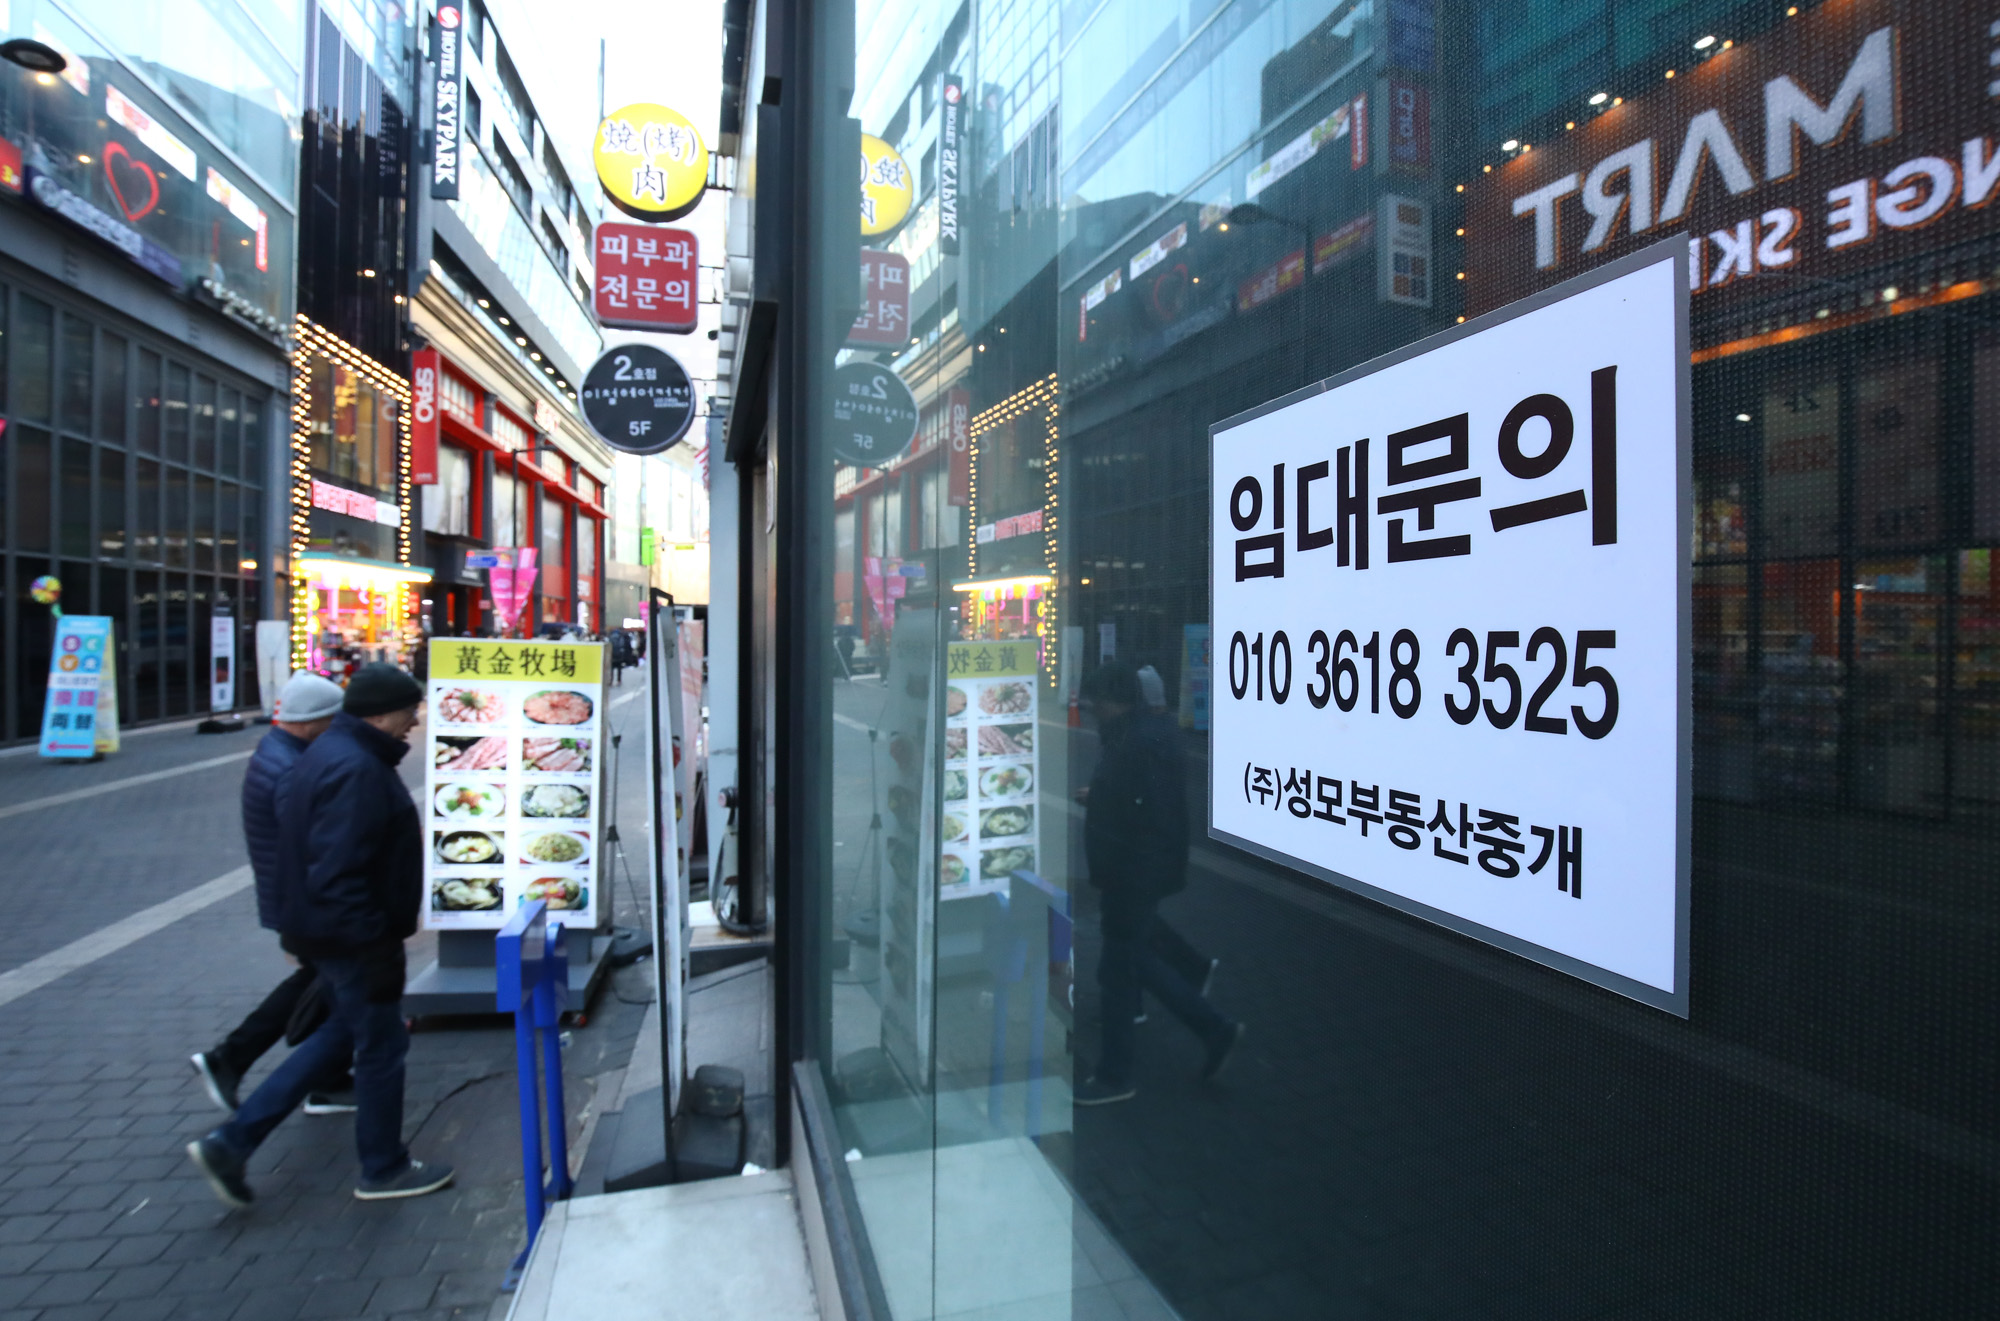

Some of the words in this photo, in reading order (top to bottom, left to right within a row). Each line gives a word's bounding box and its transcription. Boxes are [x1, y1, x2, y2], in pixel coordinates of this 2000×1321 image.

[441, 30, 457, 79] HOTEL
[435, 80, 458, 185] SKYPARK
[635, 164, 665, 201] 肉
[601, 234, 693, 270] 피부과
[600, 274, 690, 310] 전문의
[614, 355, 657, 381] 2호점
[415, 367, 435, 423] SPAO
[629, 421, 652, 436] 5F
[1230, 365, 1618, 582] 임대문의
[1230, 630, 1292, 705] 010
[1307, 629, 1422, 720] 3618
[1445, 626, 1619, 740] 3525
[1243, 762, 1582, 900] (주)성모부동산중개
